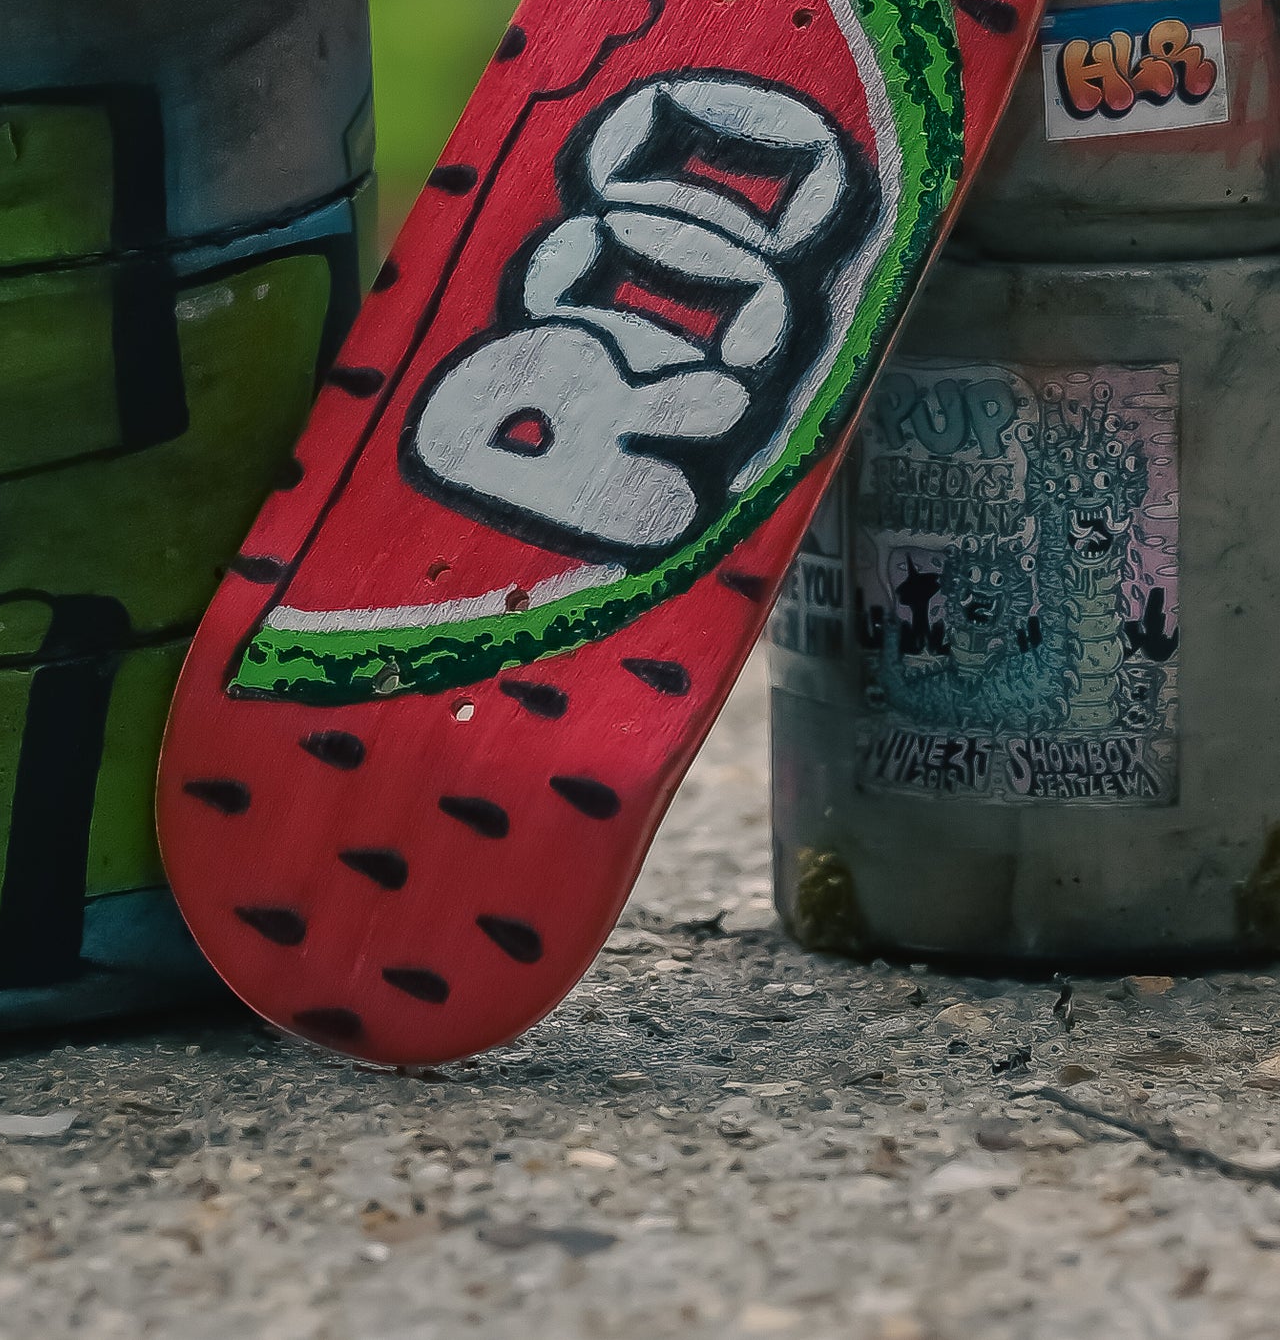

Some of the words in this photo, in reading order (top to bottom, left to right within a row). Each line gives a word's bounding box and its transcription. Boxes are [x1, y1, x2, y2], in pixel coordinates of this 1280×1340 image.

[877, 373, 1015, 459] PUP
[1007, 735, 1148, 796] SHOWBOX
[1034, 772, 1118, 798] SEATTLE
[1120, 771, 1158, 798] WA
